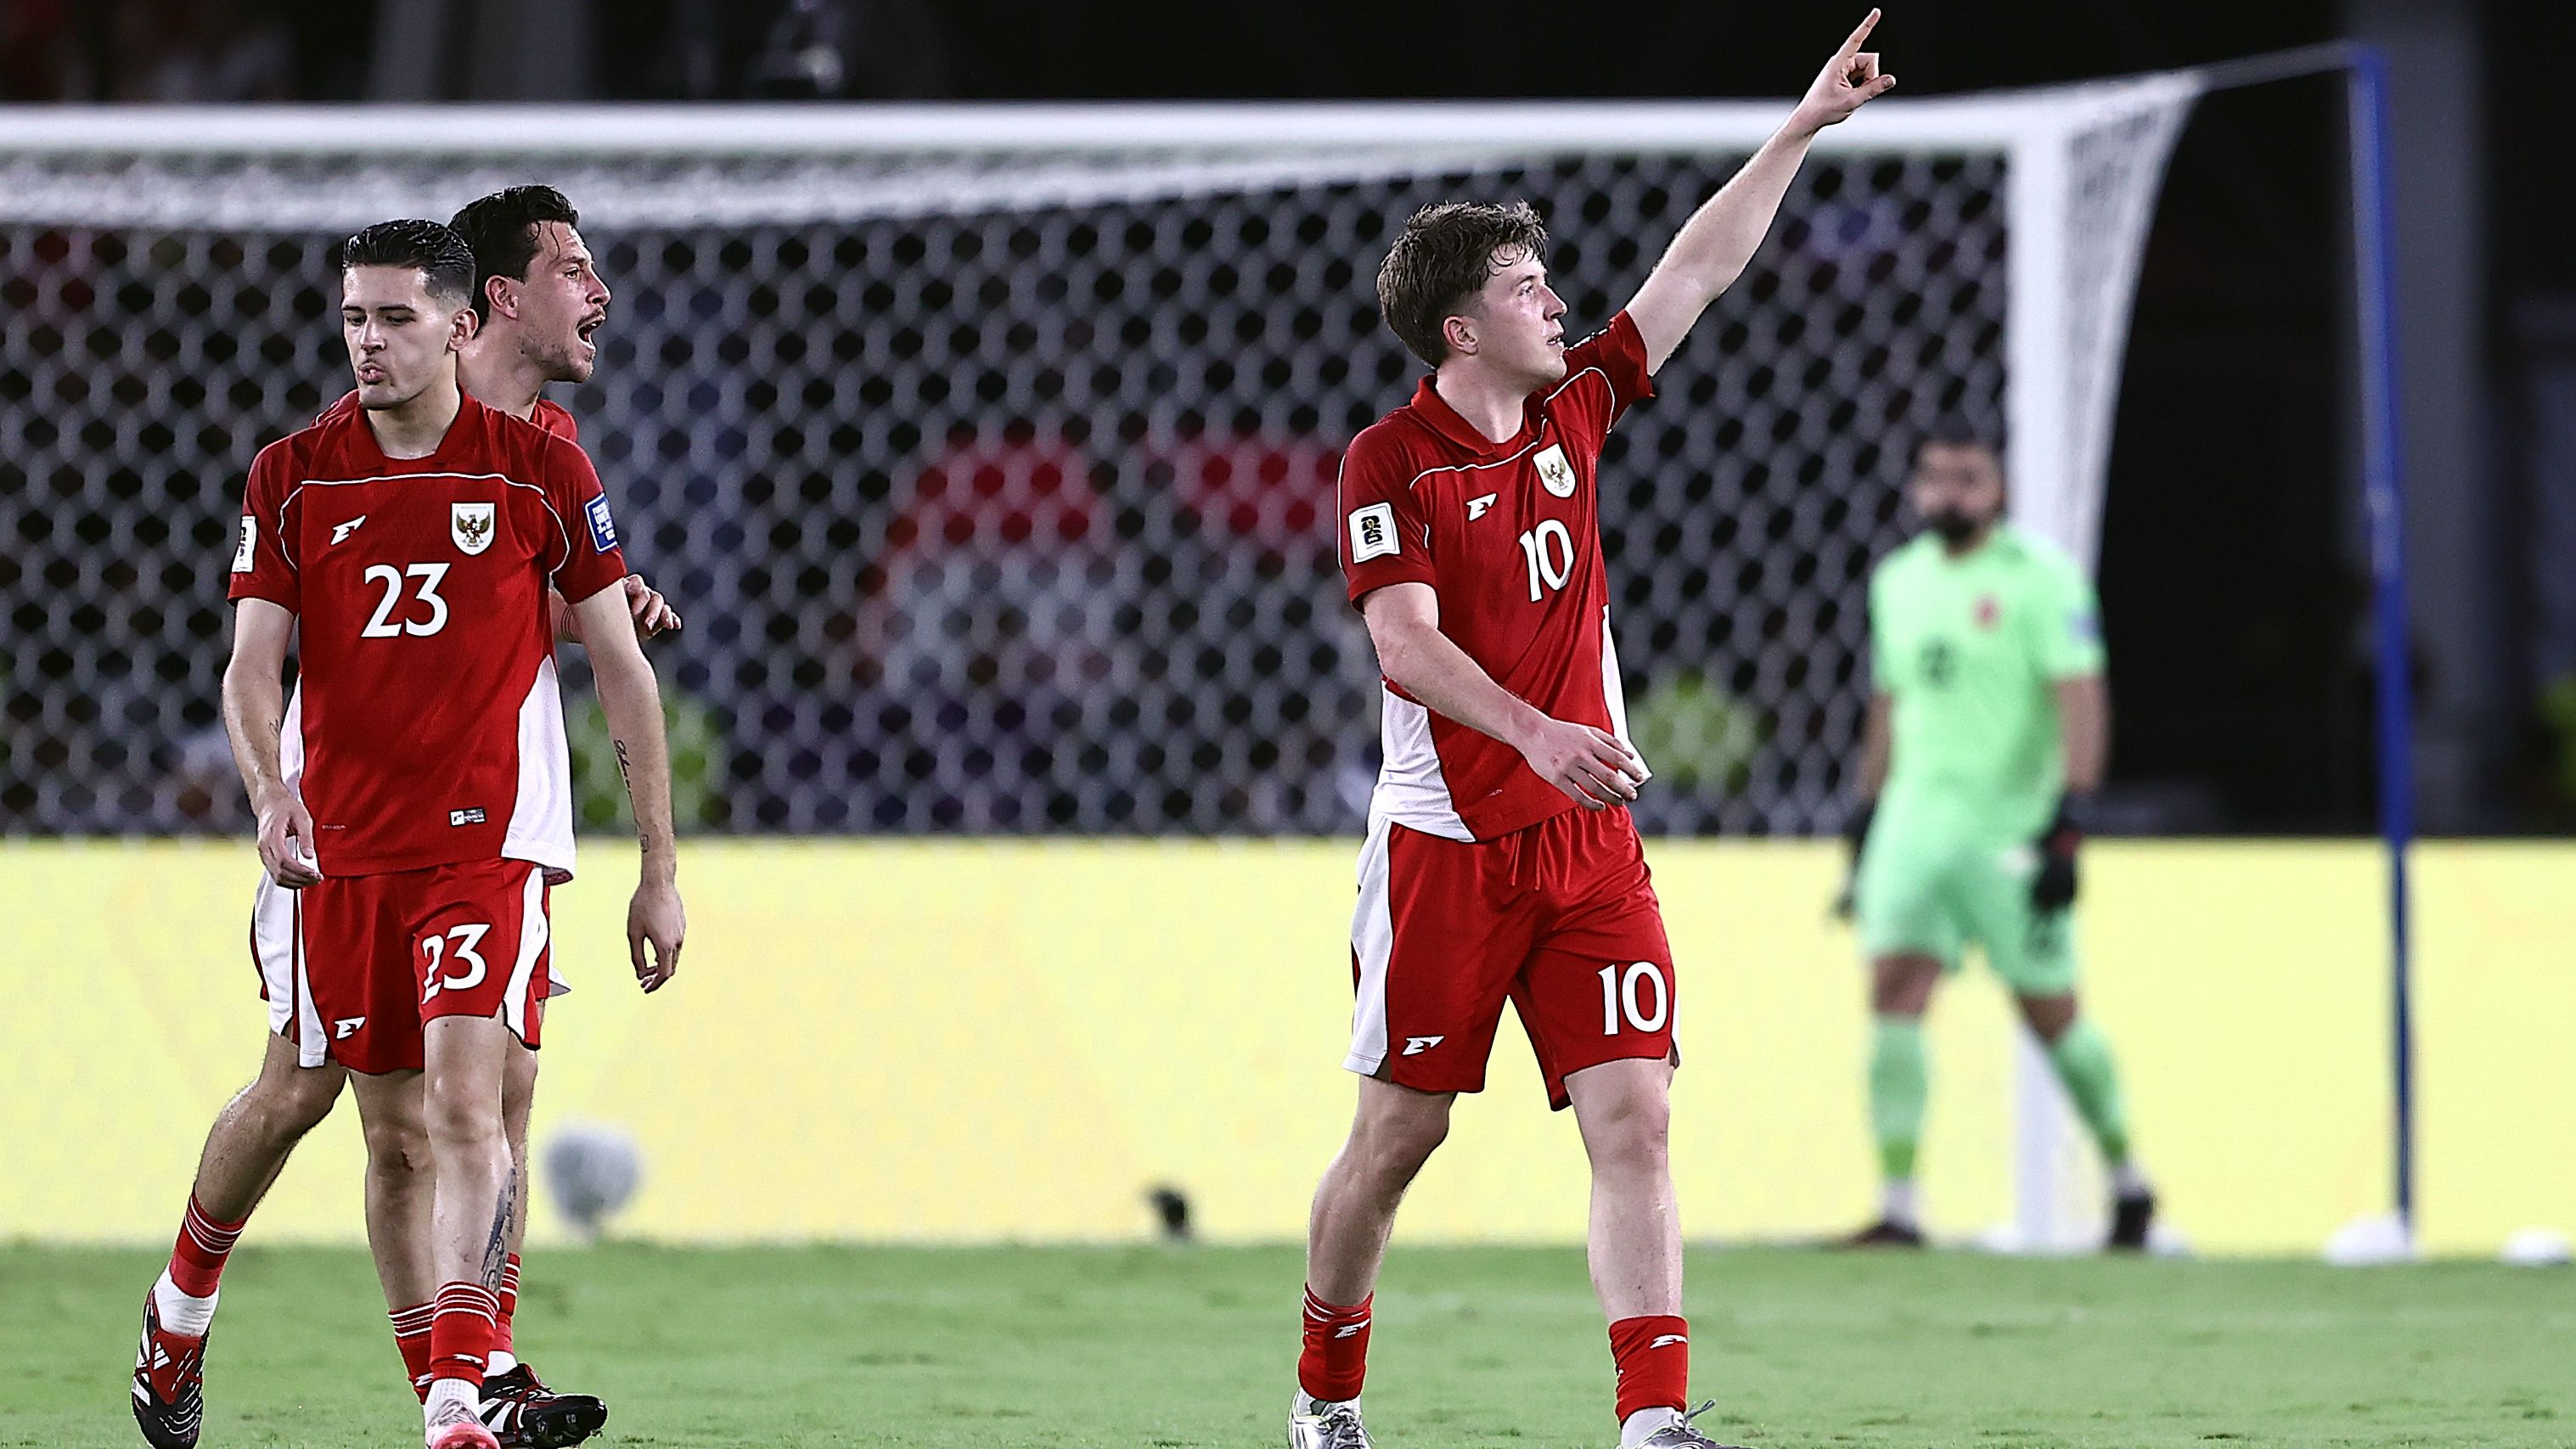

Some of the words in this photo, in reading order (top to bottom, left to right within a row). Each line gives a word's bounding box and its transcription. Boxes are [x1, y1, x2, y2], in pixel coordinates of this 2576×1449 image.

[1519, 519, 1574, 602] 10
[361, 563, 451, 637] 23
[421, 924, 491, 1005] 23
[1597, 961, 1668, 1036] 10
